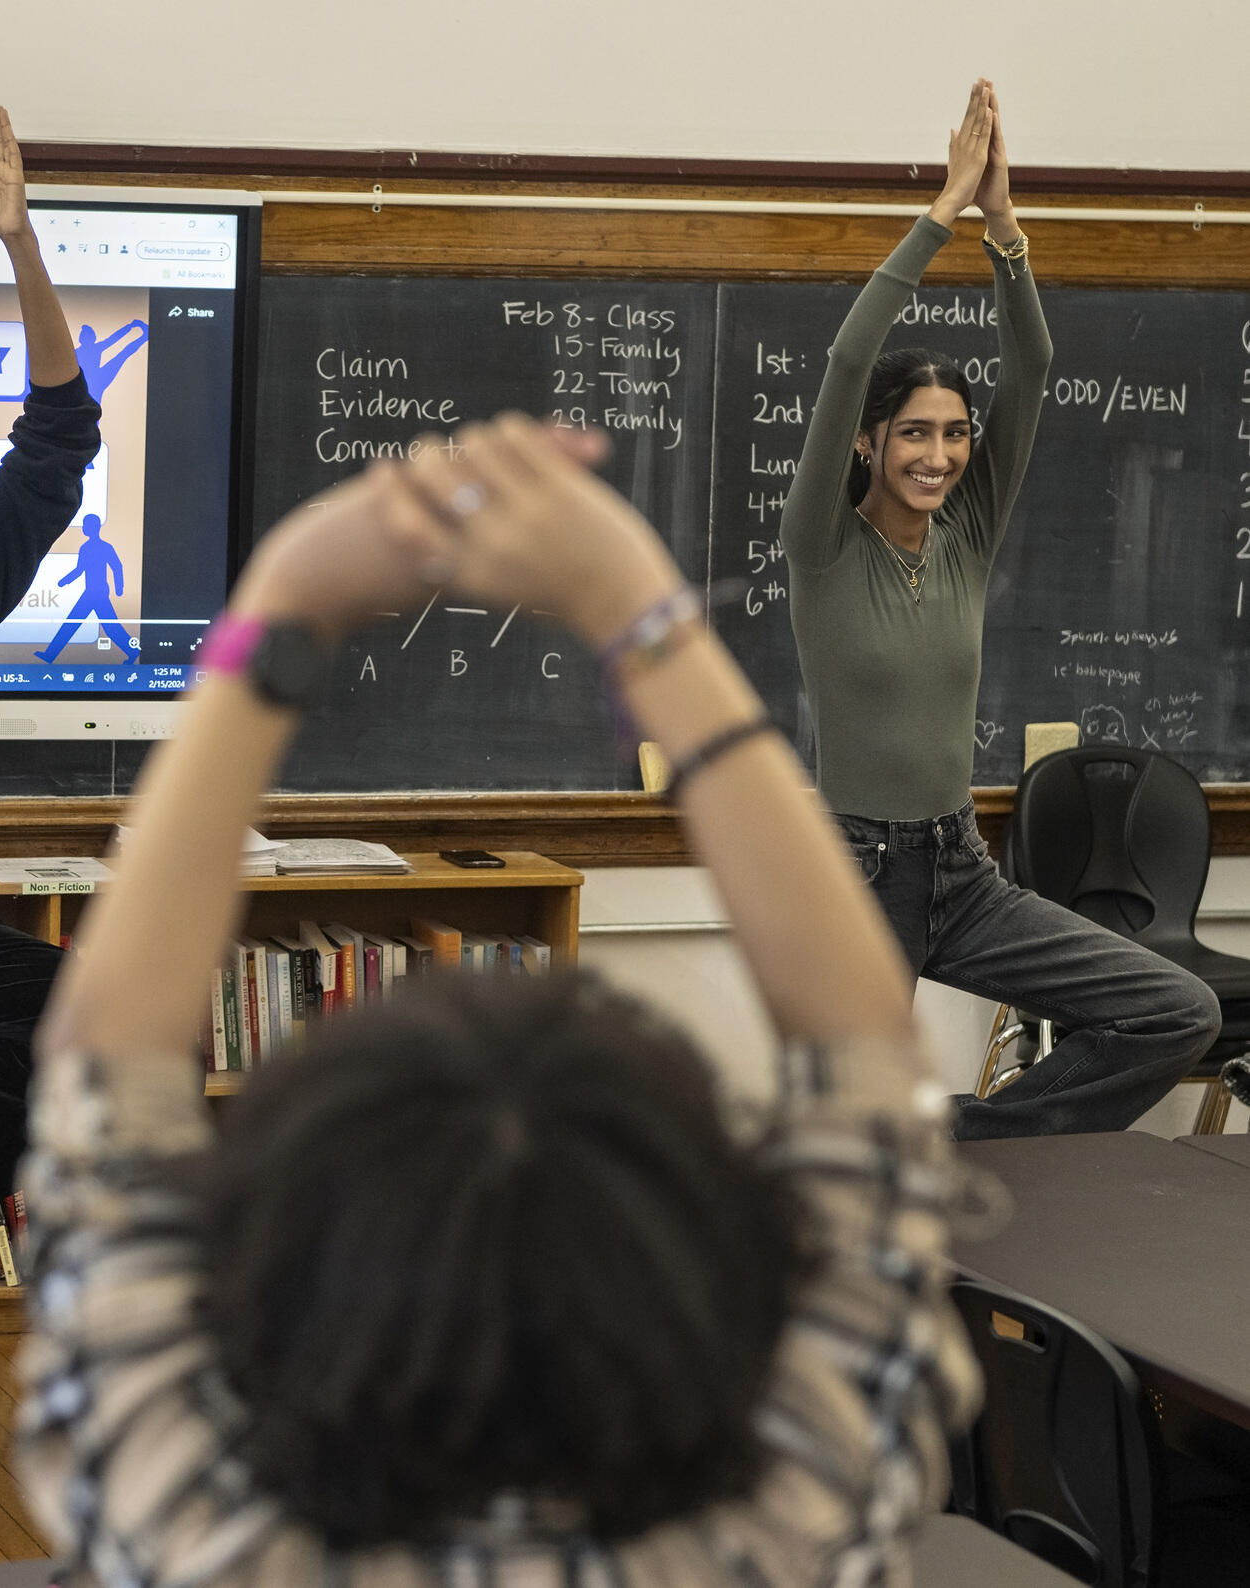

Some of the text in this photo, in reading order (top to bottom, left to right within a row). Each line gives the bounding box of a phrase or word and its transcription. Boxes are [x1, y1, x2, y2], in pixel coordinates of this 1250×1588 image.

[187, 307, 215, 318] Share
[502, 301, 554, 326] Feb
[607, 304, 676, 333] Class
[316, 348, 408, 380] Claim
[601, 337, 681, 377] Family
[598, 371, 671, 399] Town
[319, 389, 461, 423] Evidence
[605, 405, 682, 450] Family
[746, 580, 786, 617] 6th
[153, 668, 182, 676] 1:25 PM
[360, 649, 561, 681] A B C
[148, 680, 186, 689] 2/15/2024
[29, 883, 50, 892] Non
[58, 882, 91, 892] Fiction
